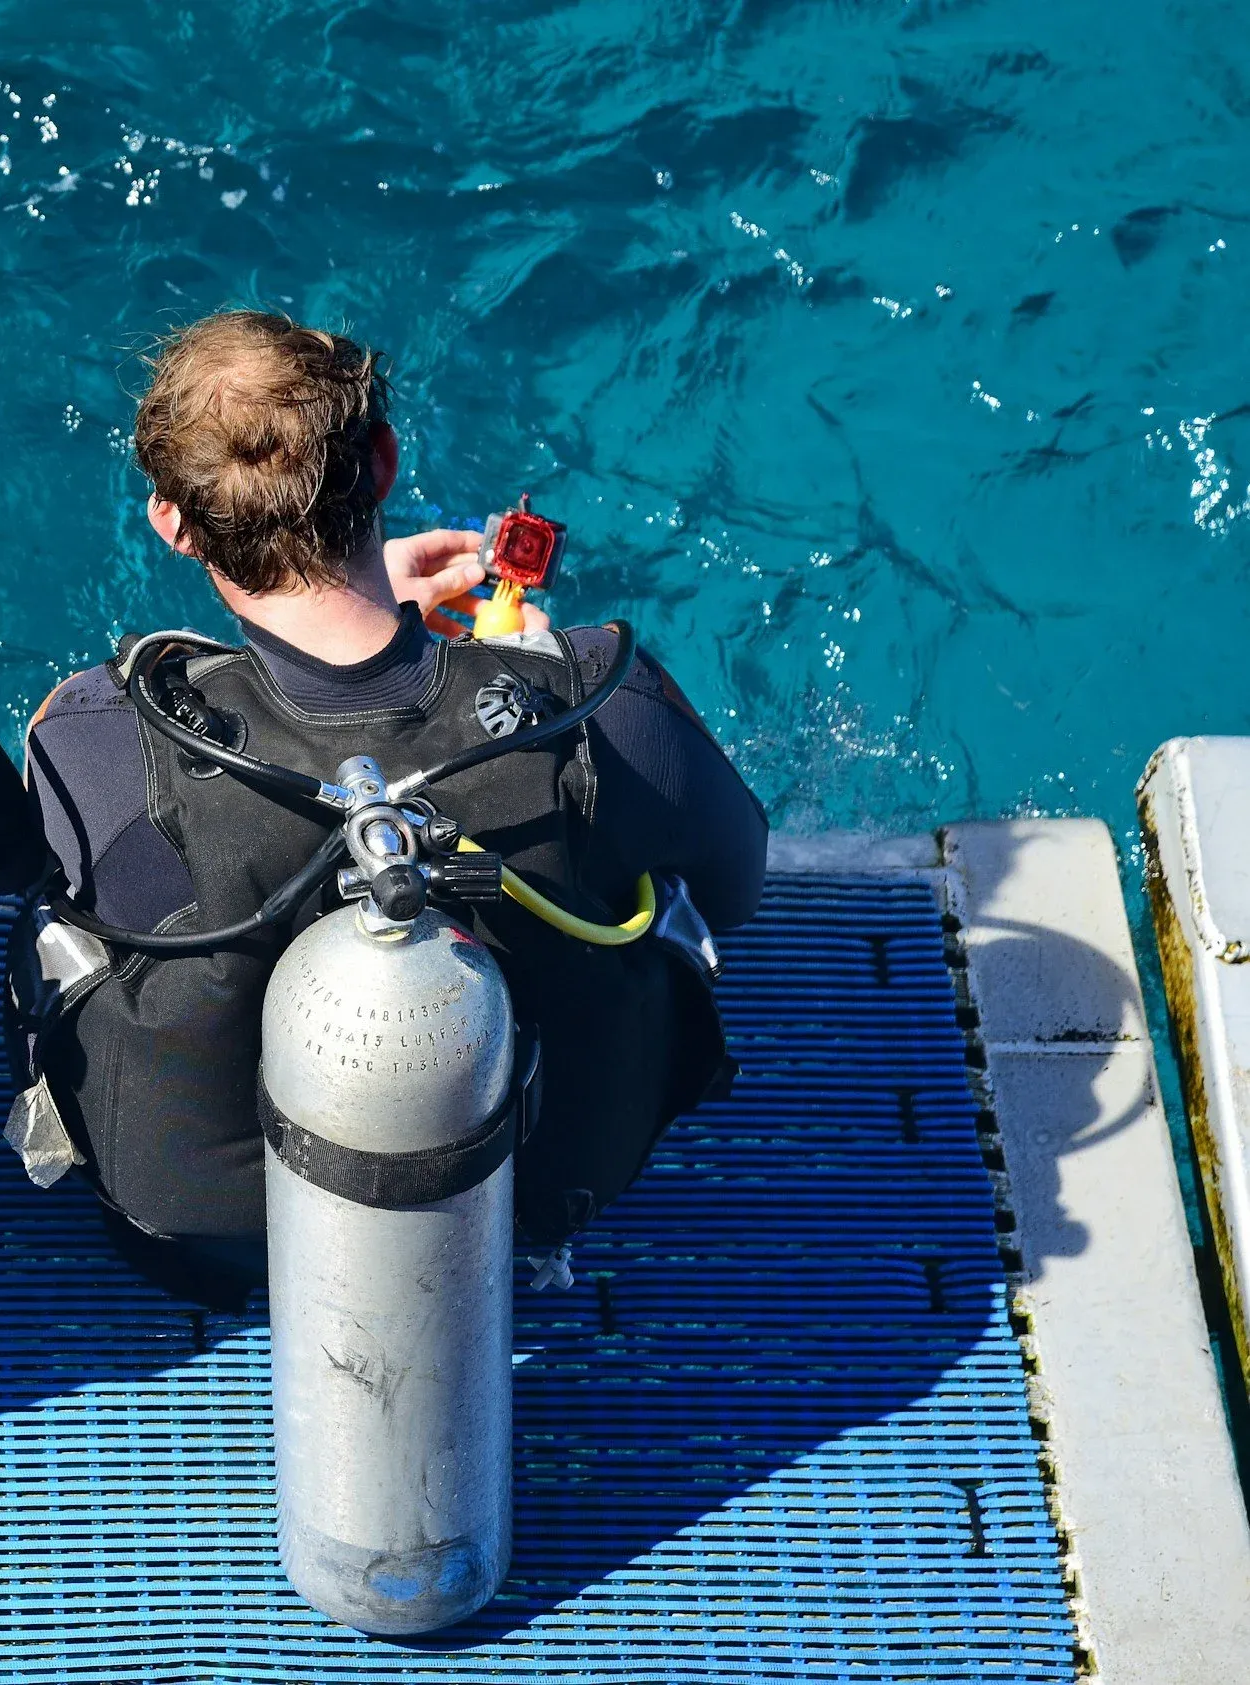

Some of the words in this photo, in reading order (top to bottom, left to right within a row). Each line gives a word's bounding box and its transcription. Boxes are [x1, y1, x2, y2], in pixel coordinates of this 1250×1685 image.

[401, 1016, 469, 1047] LUXFER
[305, 1039, 323, 1055] AT
[341, 1055, 373, 1071] 15C
